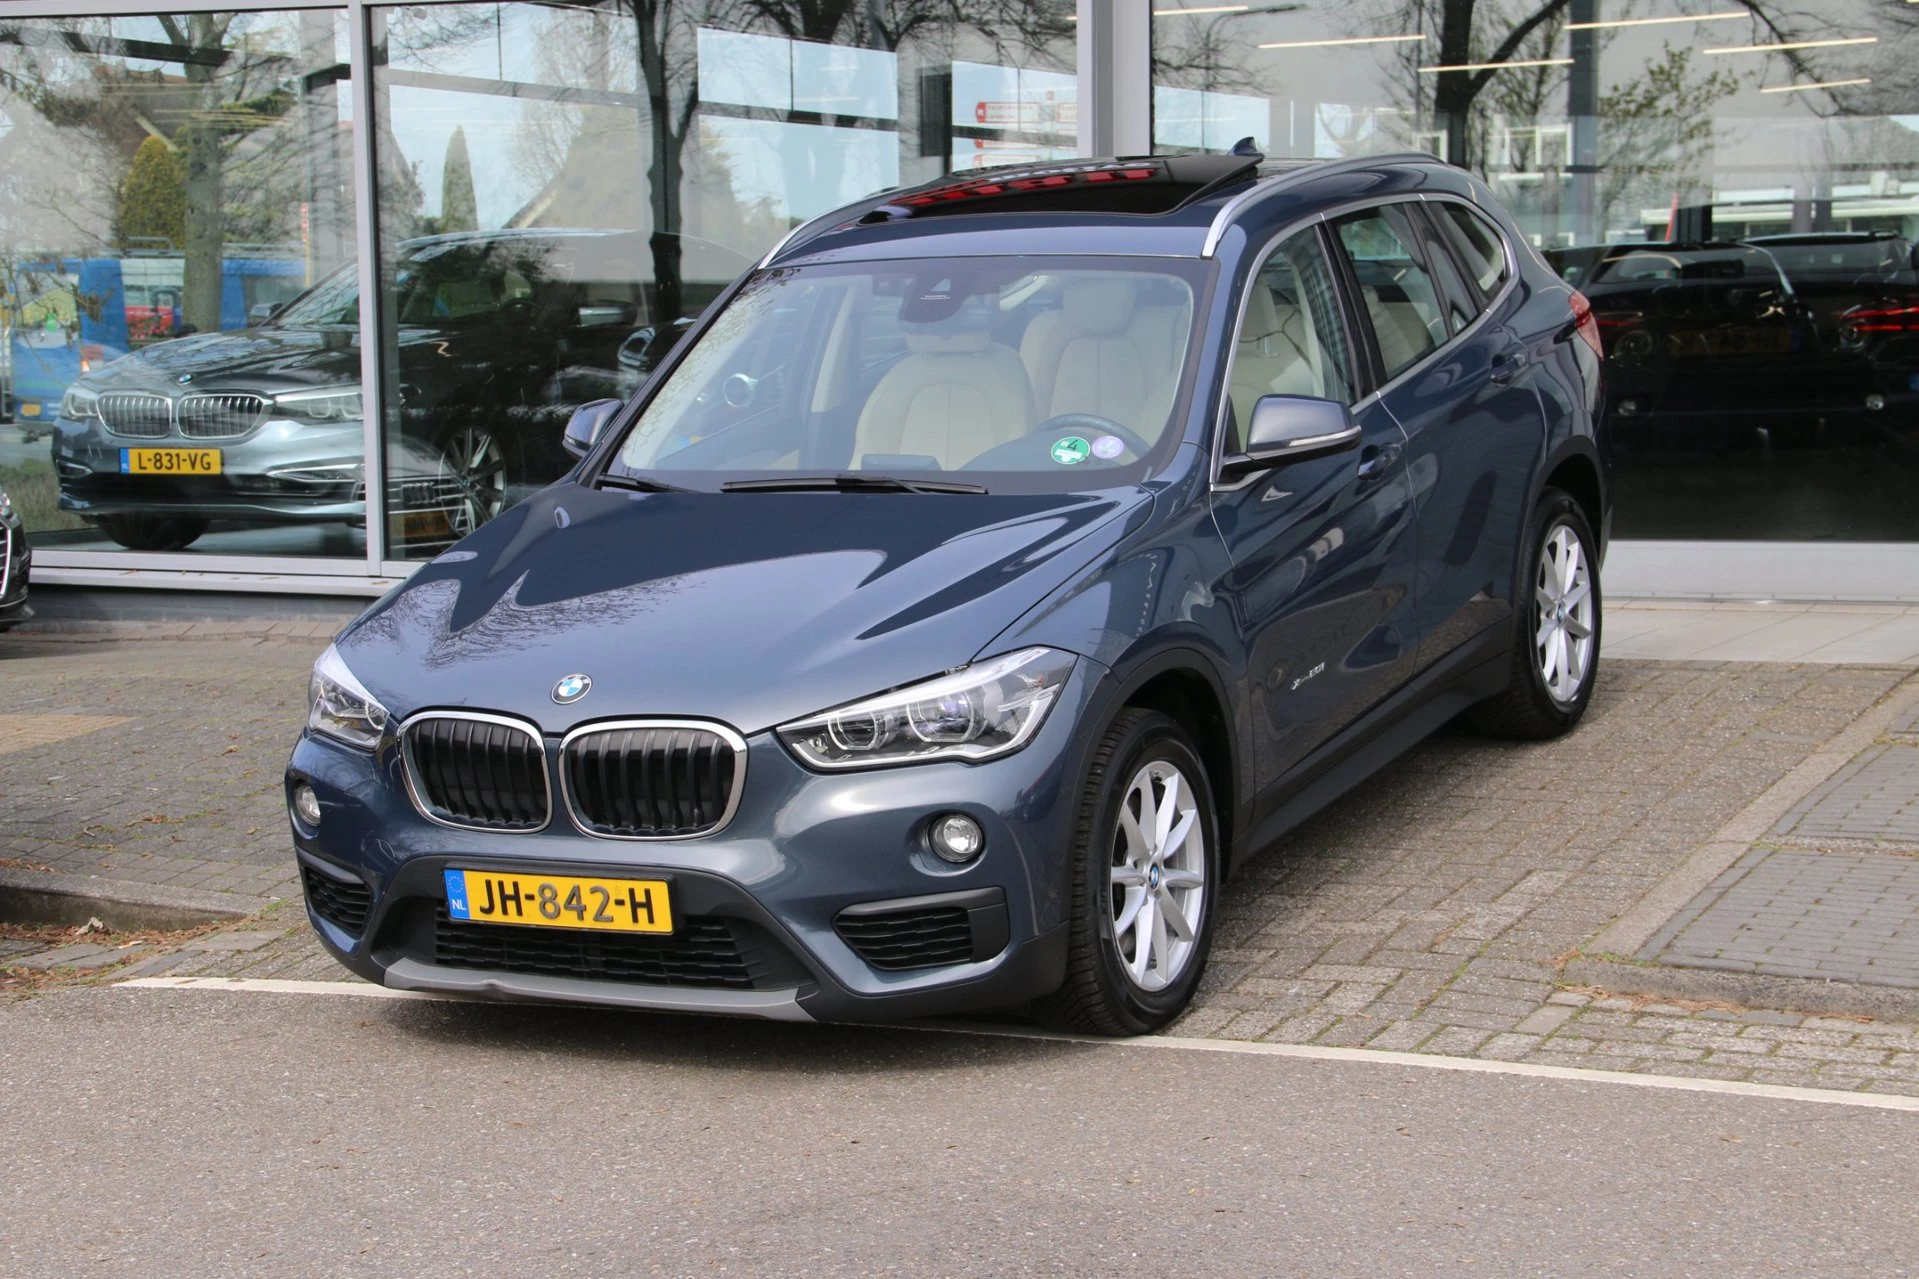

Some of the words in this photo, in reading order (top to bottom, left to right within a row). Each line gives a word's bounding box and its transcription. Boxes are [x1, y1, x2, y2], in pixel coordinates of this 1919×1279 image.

[1067, 439, 1078, 451] 4
[137, 452, 211, 471] L-831-VG
[451, 898, 467, 911] NL
[479, 878, 655, 924] JH-842-H
